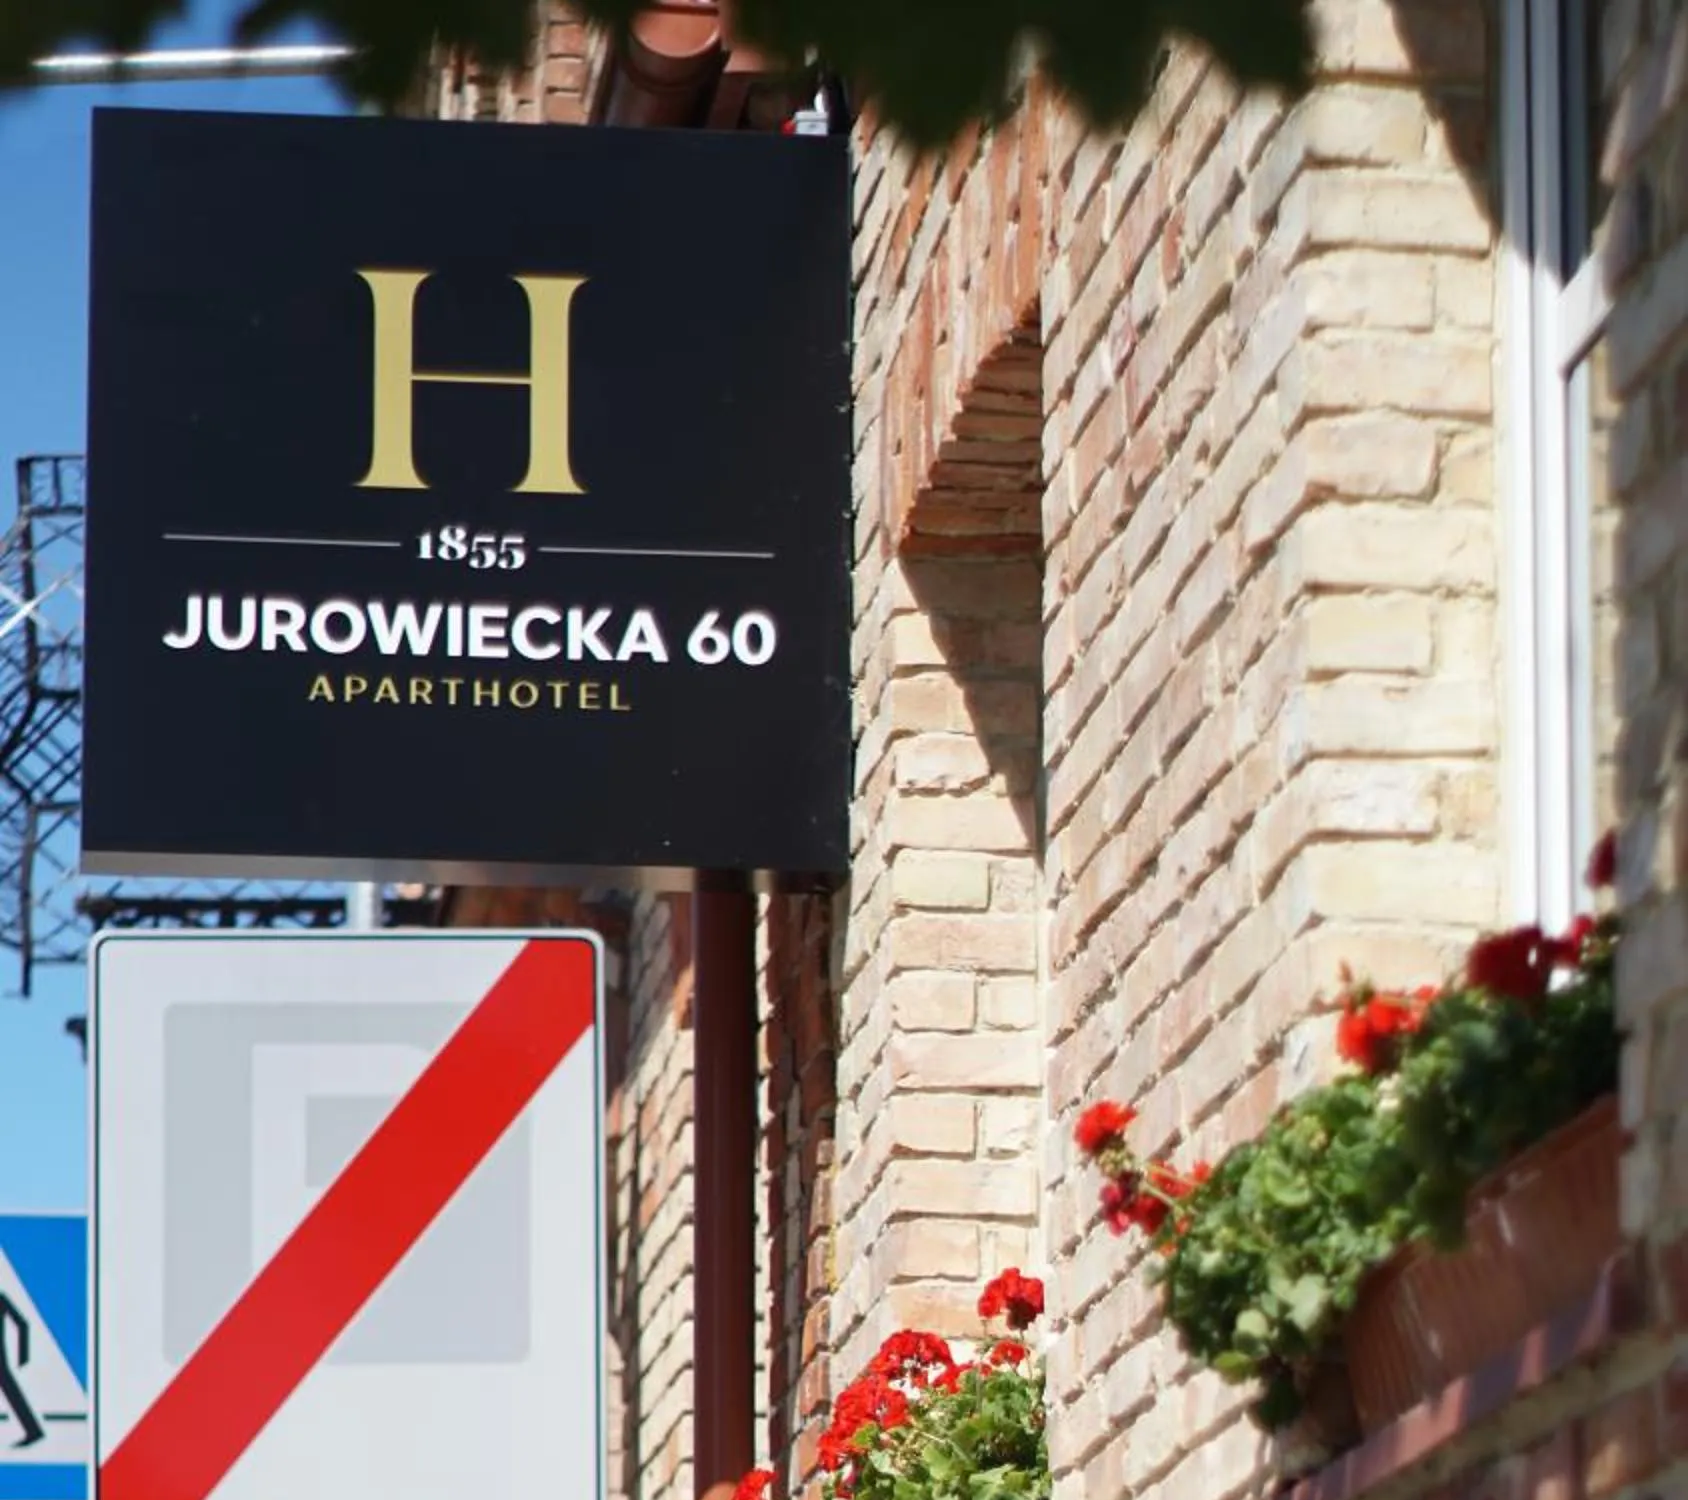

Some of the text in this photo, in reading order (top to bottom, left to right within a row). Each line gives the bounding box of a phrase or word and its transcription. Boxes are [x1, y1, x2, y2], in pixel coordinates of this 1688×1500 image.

[355, 268, 588, 496] H
[416, 524, 527, 570] 1855
[162, 594, 778, 667] JUROWIECKA 60
[308, 675, 631, 711] APARTHOTEL
